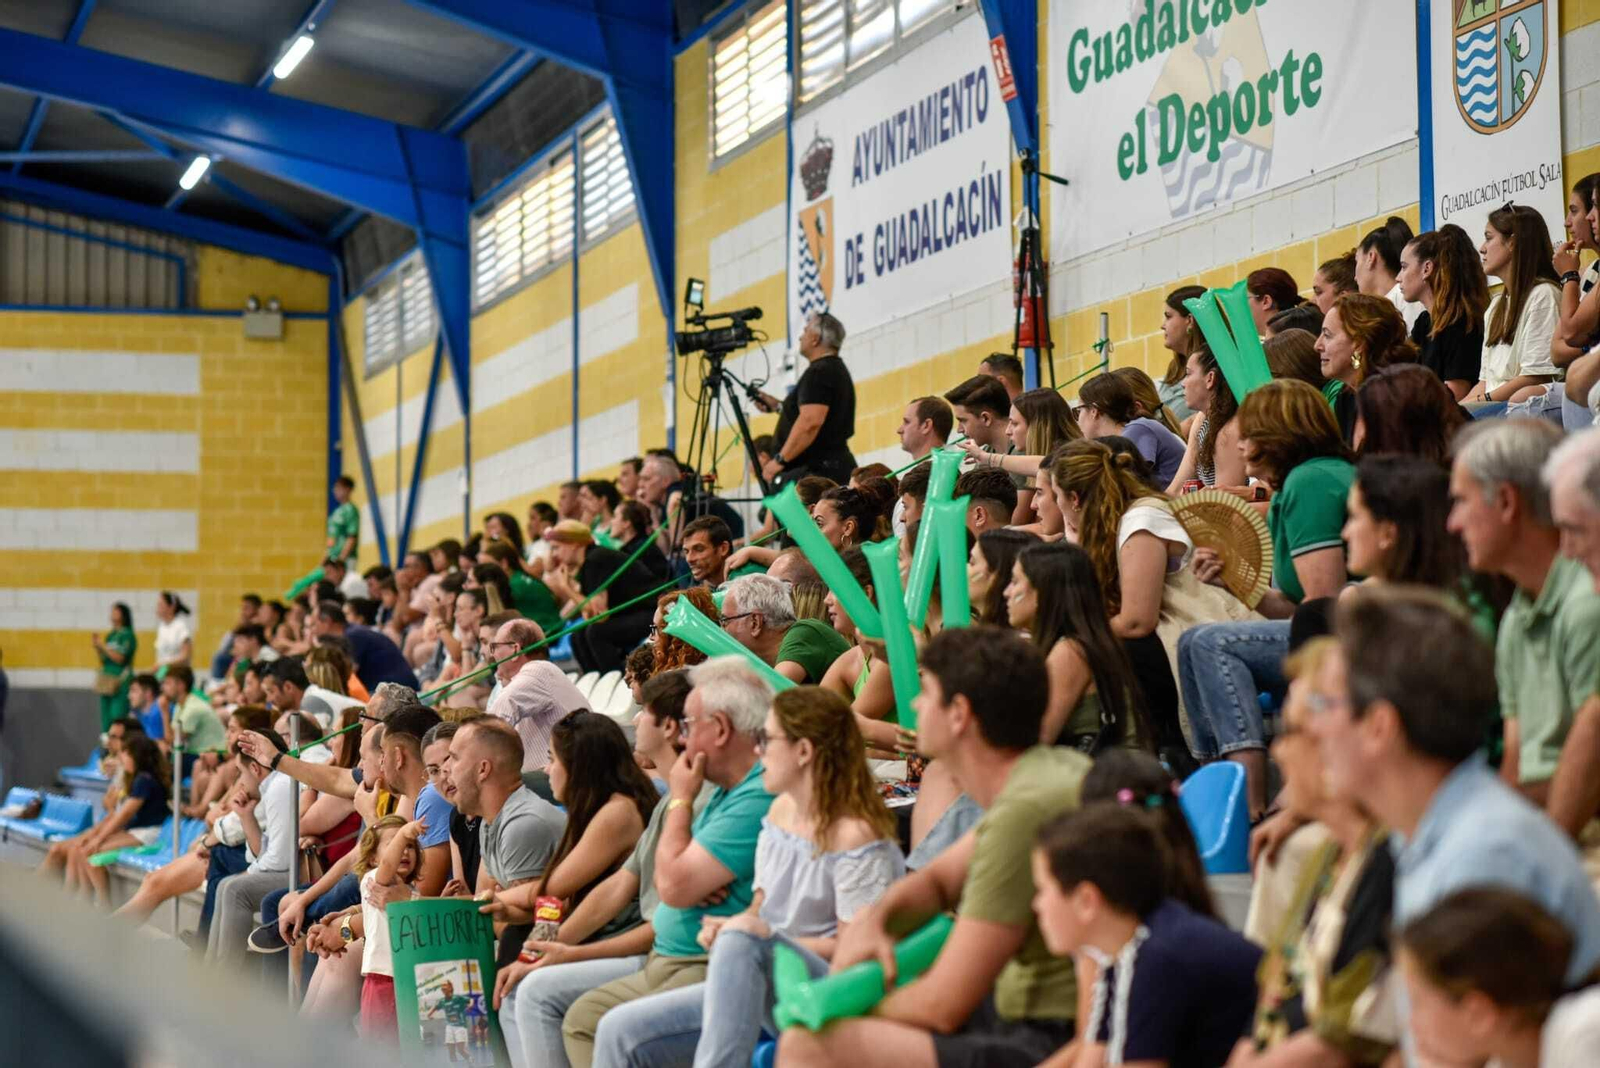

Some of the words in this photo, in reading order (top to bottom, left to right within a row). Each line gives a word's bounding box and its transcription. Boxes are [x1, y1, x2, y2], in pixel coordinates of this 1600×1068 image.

[1068, 0, 1267, 93] Guadalca
[853, 66, 989, 187] AYUNTAMIENTO
[1118, 108, 1147, 181] el
[1158, 49, 1322, 166] Deporte
[845, 233, 865, 290] DE
[874, 161, 1002, 277] GUADALCACÍN
